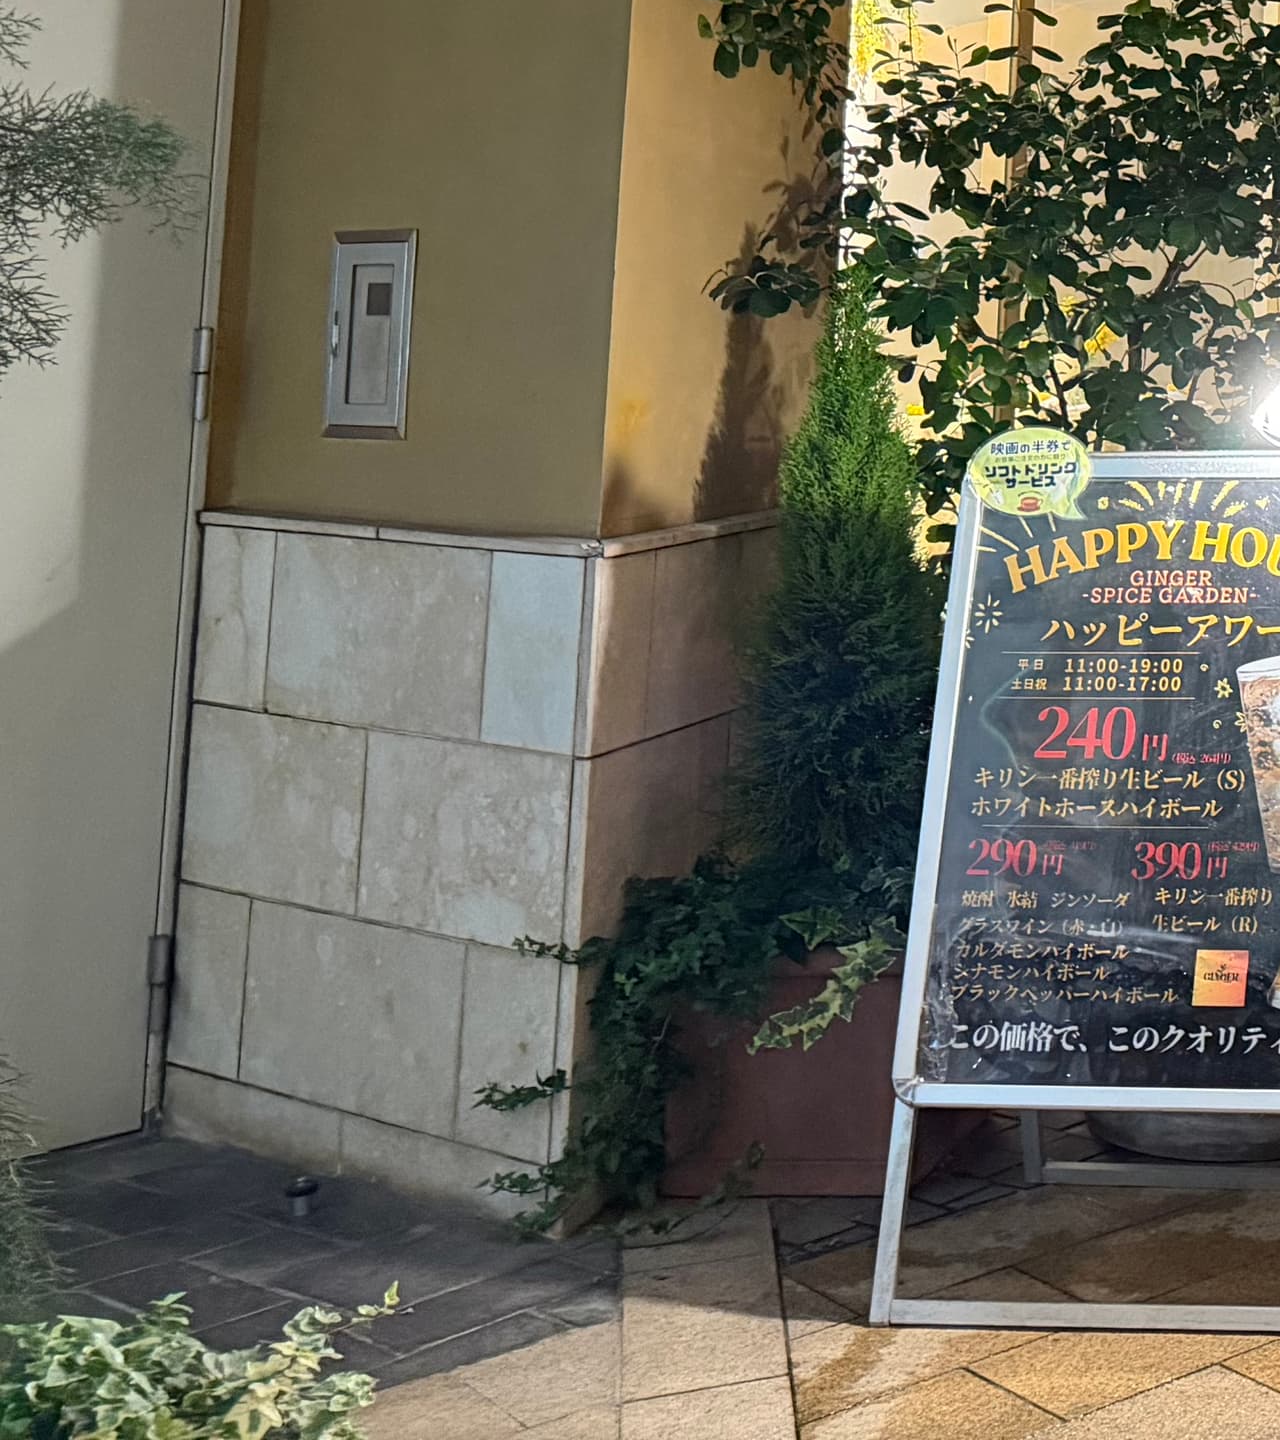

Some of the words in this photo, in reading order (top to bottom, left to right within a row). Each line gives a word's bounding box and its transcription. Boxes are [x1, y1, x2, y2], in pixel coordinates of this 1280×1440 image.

[990, 440, 1071, 456] 映画の半券で
[984, 462, 1077, 478] ソフトドリンク
[1005, 475, 1057, 489] サービス
[1003, 519, 1185, 594] HAPPY
[1130, 570, 1213, 587] GINGER
[1017, 658, 1044, 671] 平日
[1064, 658, 1183, 674] 11:00-19:00
[1011, 678, 1047, 691] 土日祝
[1062, 676, 1182, 692] 11:00-17:00
[970, 796, 1223, 820] ホワイトホースハイボール
[961, 889, 993, 908] 焼酎
[1051, 891, 1132, 909] ジンソーダ
[1153, 886, 1274, 907] キリン一番搾り
[956, 942, 1129, 960] カルダモンハイボール
[953, 962, 1111, 982] シナモンハイボール
